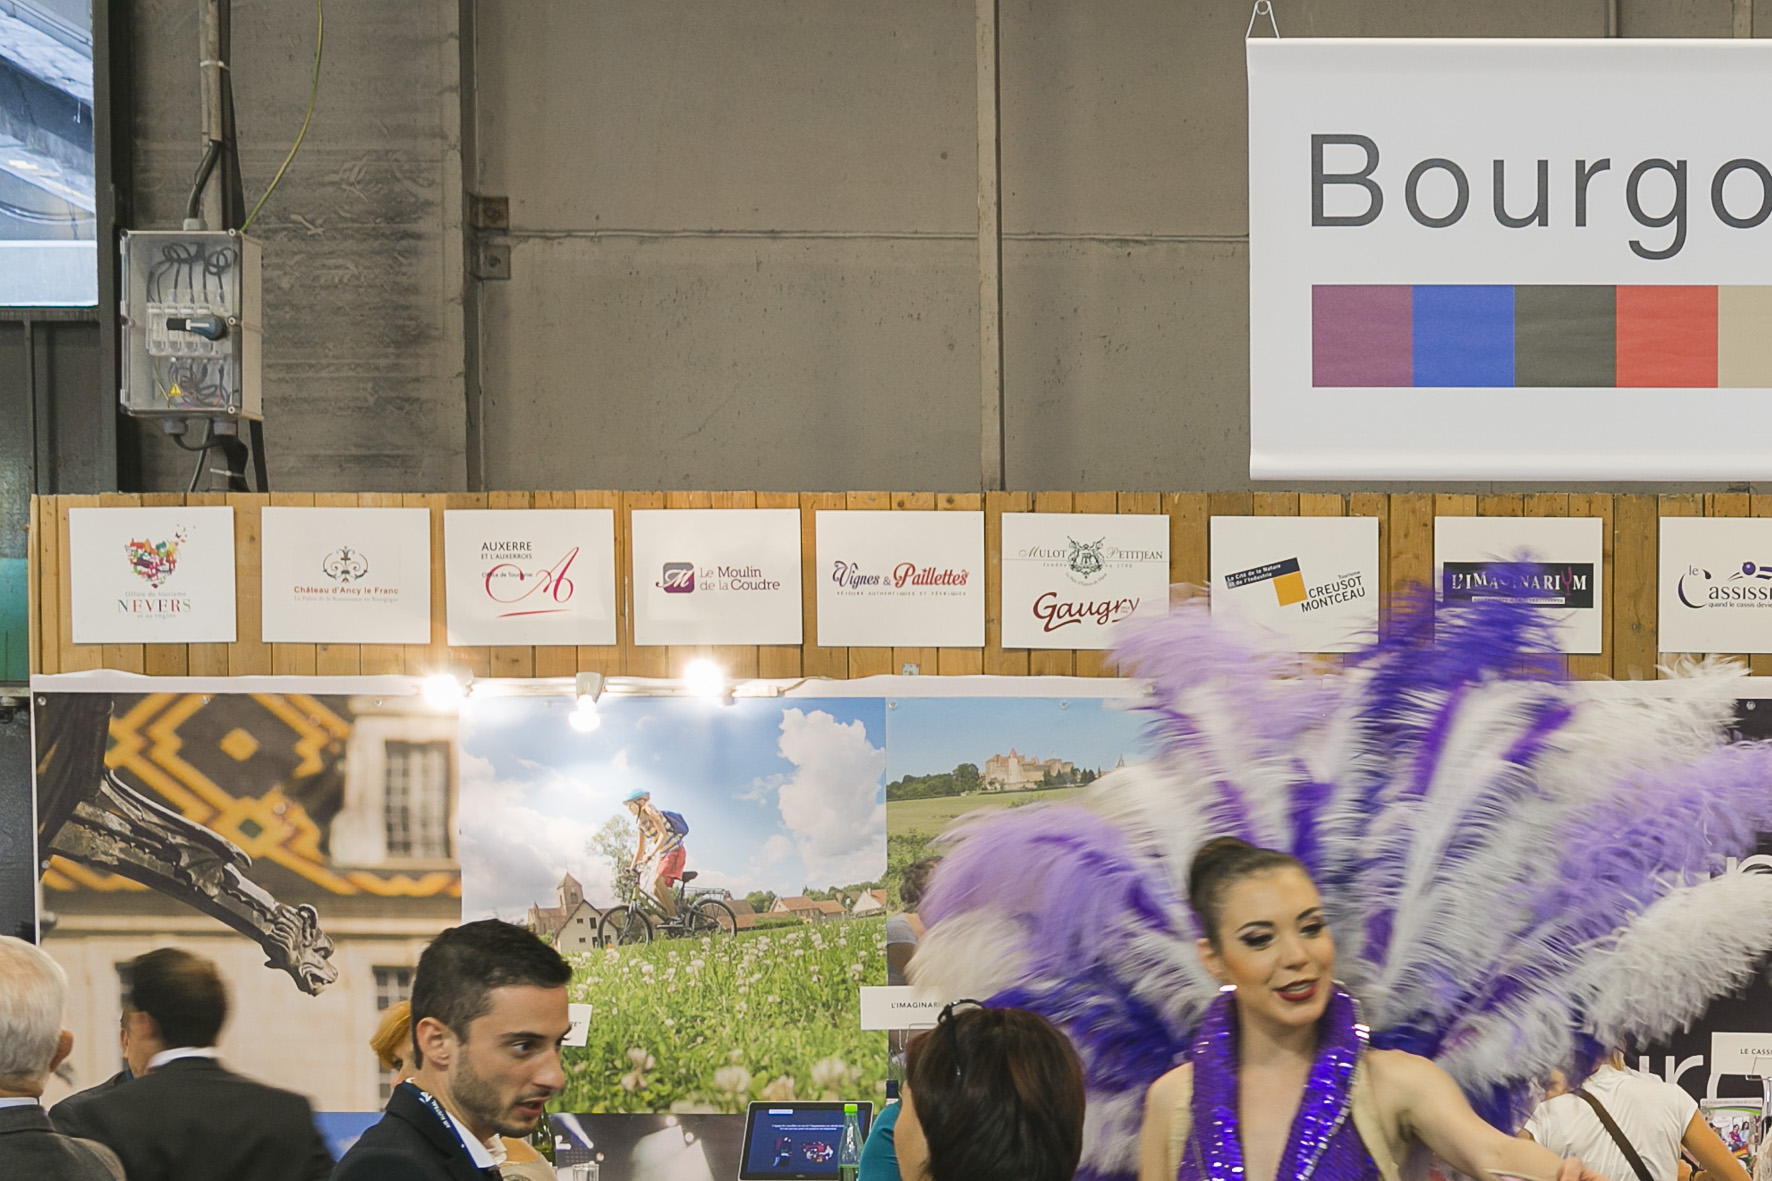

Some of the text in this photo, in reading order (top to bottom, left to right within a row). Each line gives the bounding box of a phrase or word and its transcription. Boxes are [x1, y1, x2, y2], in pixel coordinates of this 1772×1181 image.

[481, 541, 532, 551] AUXERRE
[1019, 546, 1066, 559] MULOT
[700, 566, 762, 578] Le Moulin
[832, 560, 969, 590] Vignes & Paillettes
[1689, 565, 1699, 576] le
[294, 586, 329, 594] Château
[332, 586, 361, 595] d'Ancy
[700, 578, 780, 591] de la Coudre
[1308, 576, 1362, 599] CREUSOT
[118, 600, 191, 613] NEVERS
[1301, 588, 1366, 612] MONTCEAU
[1033, 592, 1140, 632] Gaugry
